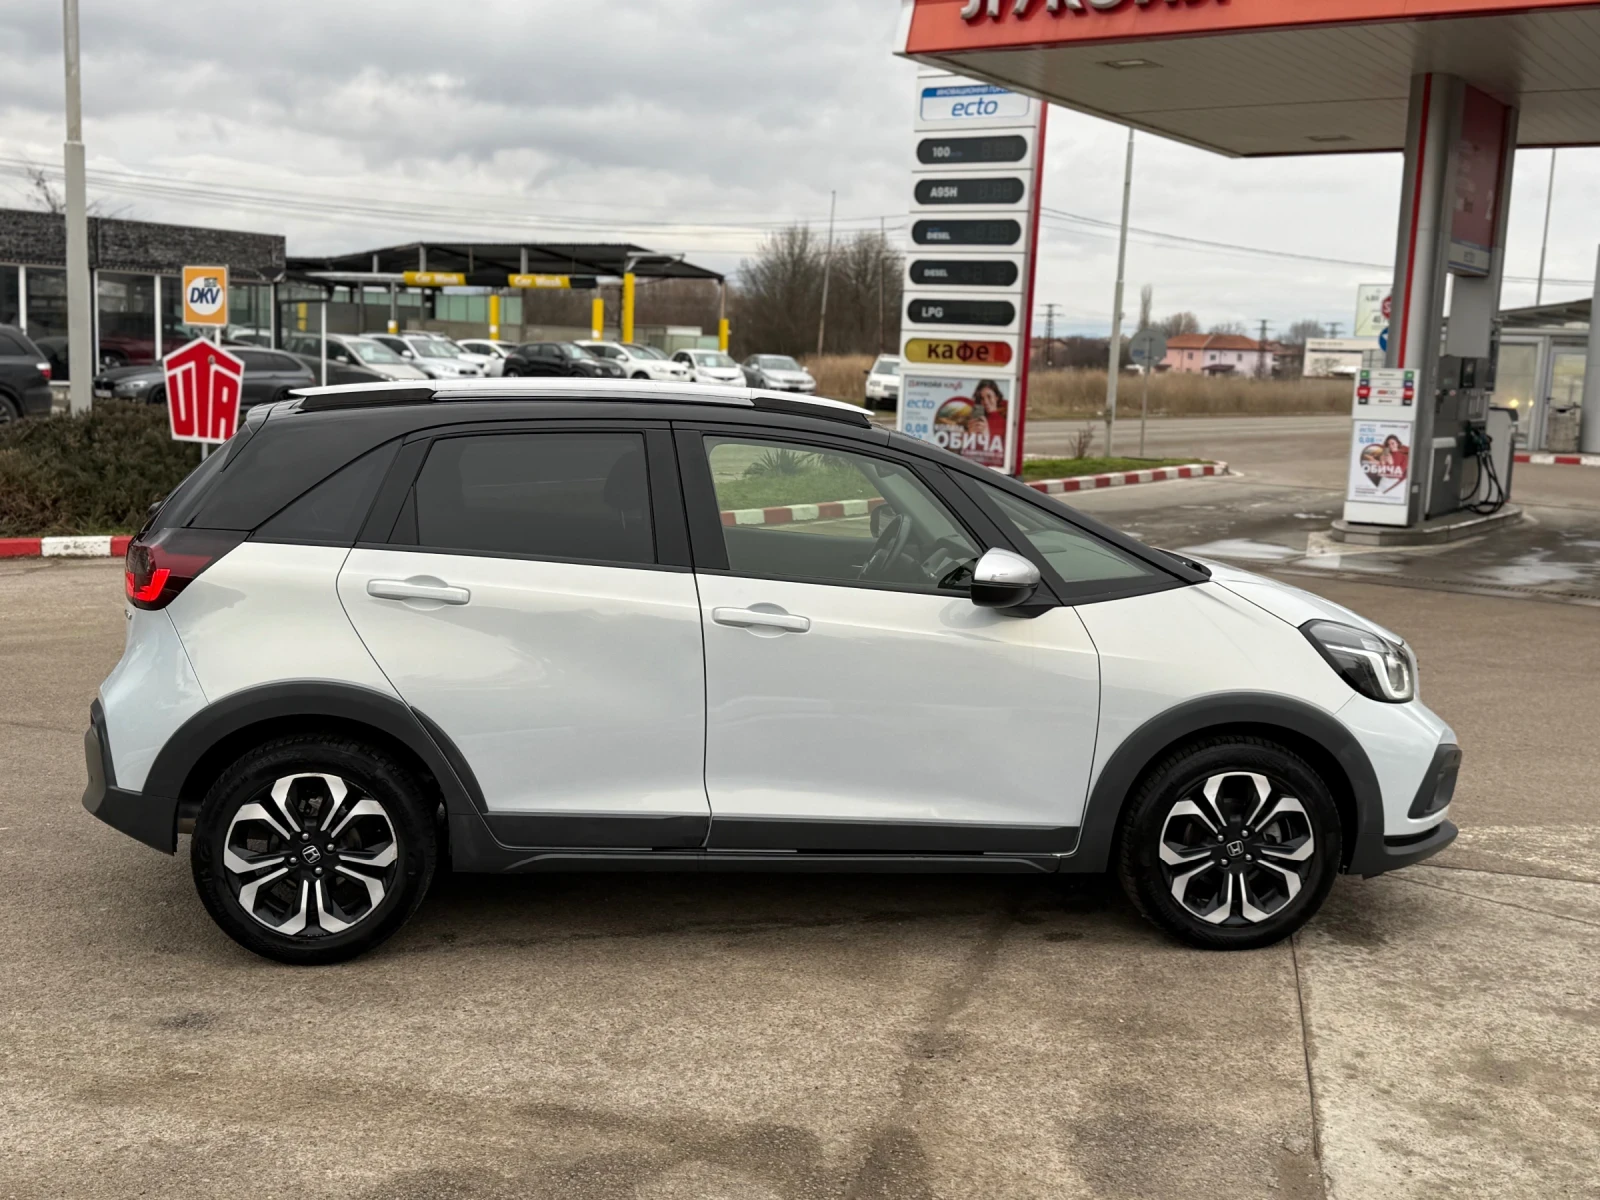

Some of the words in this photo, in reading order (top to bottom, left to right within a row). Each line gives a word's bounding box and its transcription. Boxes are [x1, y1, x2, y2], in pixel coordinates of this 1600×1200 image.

[951, 97, 998, 117] ecto
[932, 147, 950, 158] 100
[926, 231, 951, 240] DIESEL
[924, 268, 949, 277] DIESEL
[514, 276, 532, 286] Car
[190, 287, 220, 304] DKV
[921, 306, 944, 318] LPG
[927, 342, 989, 362] кафе
[166, 340, 244, 441] UTA
[907, 398, 935, 409] ecto
[934, 431, 1004, 452] ОБИЧА
[1361, 463, 1403, 476] ОБИЧА
